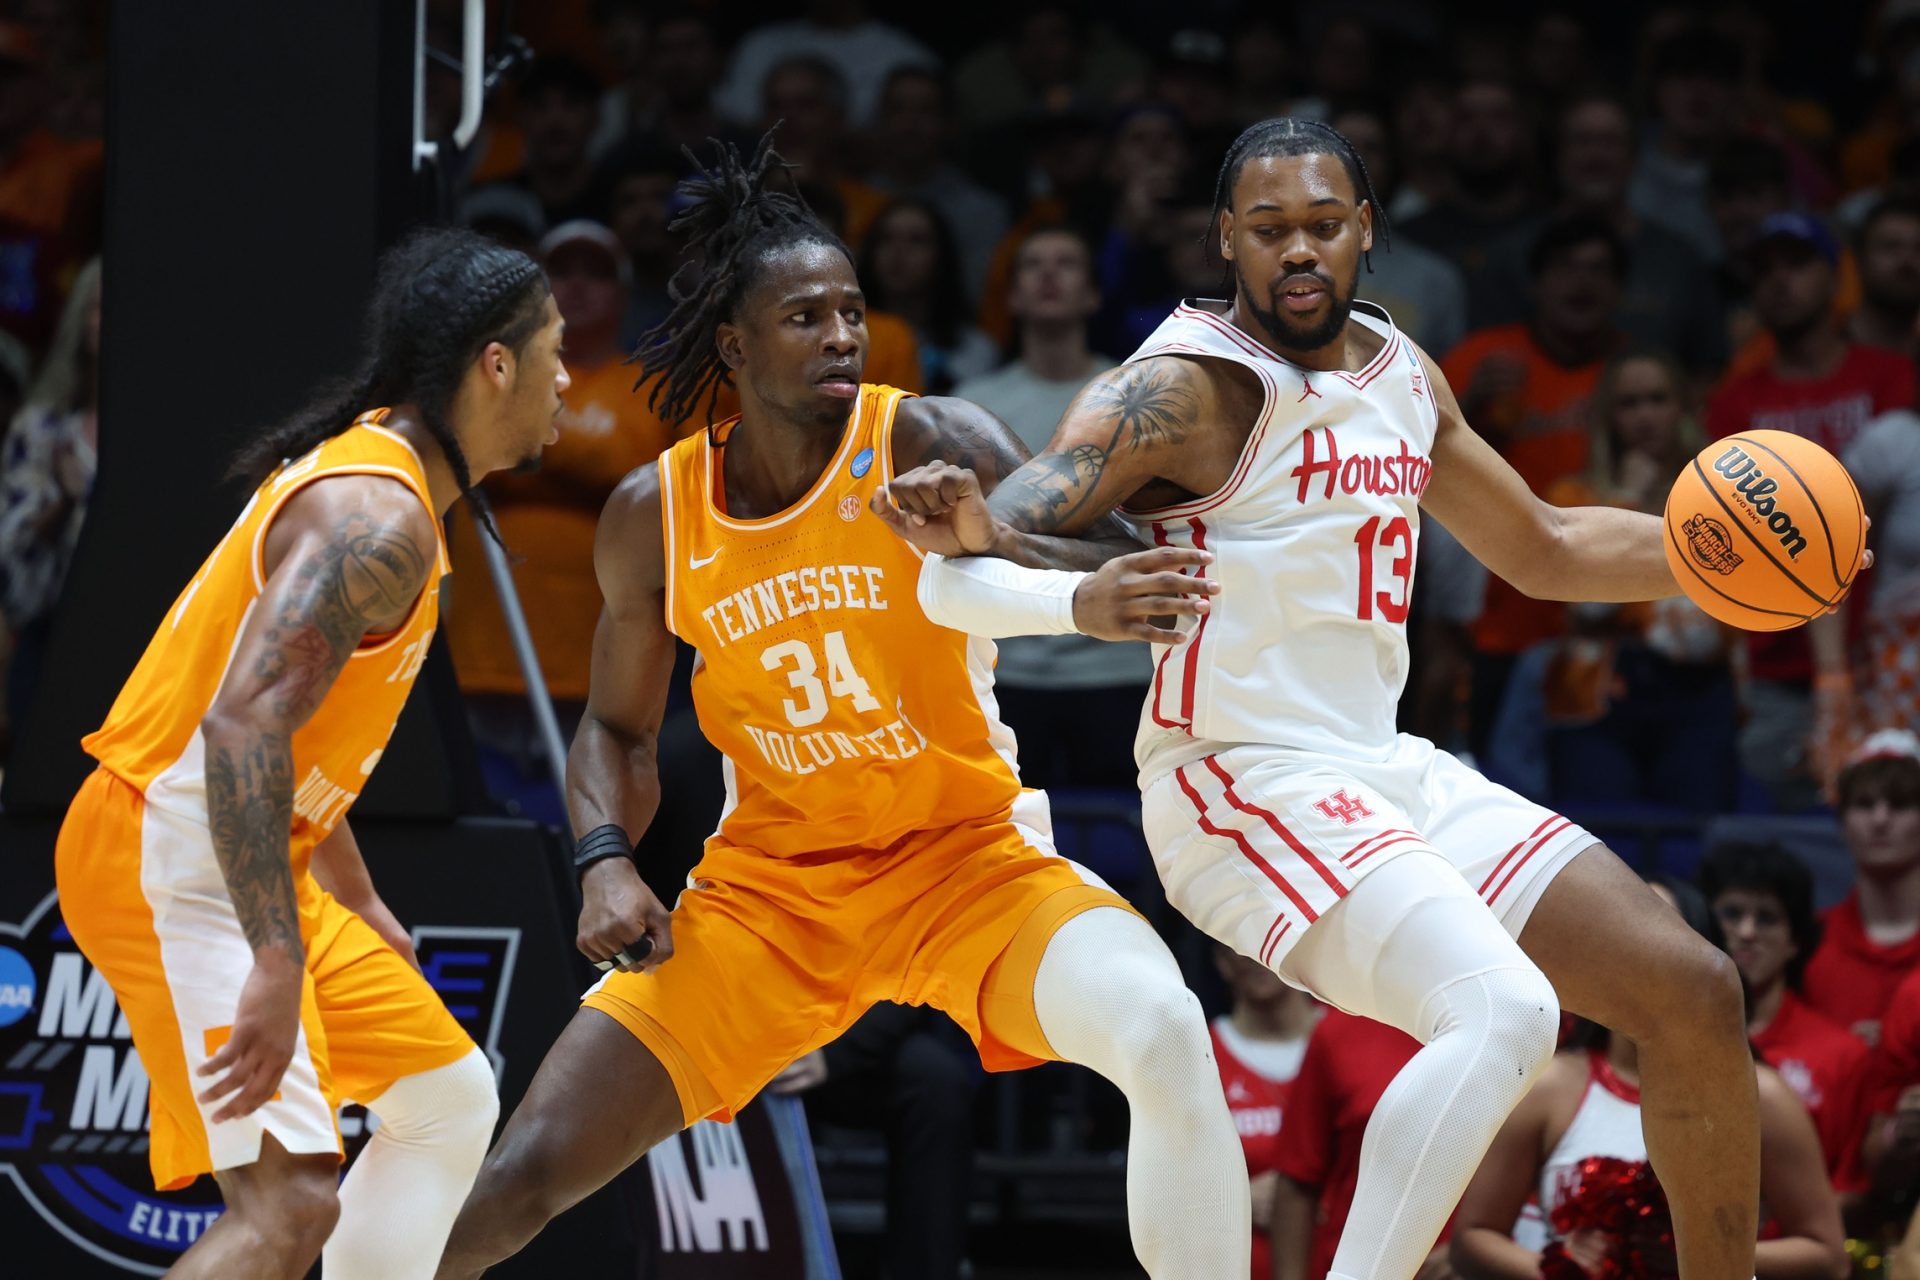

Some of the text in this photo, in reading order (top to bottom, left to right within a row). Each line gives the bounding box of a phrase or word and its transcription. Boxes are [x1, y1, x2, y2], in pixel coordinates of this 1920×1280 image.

[840, 497, 860, 520] SEC
[1699, 522, 1728, 556] MARCH
[1712, 445, 1807, 561] Wilson
[1745, 508, 1761, 525] NXT
[1354, 516, 1412, 624] 13
[1694, 534, 1734, 574] MADNESS
[702, 565, 888, 647] TENNESSEE
[760, 630, 882, 728] 34
[743, 697, 927, 774] VOLUNTEE
